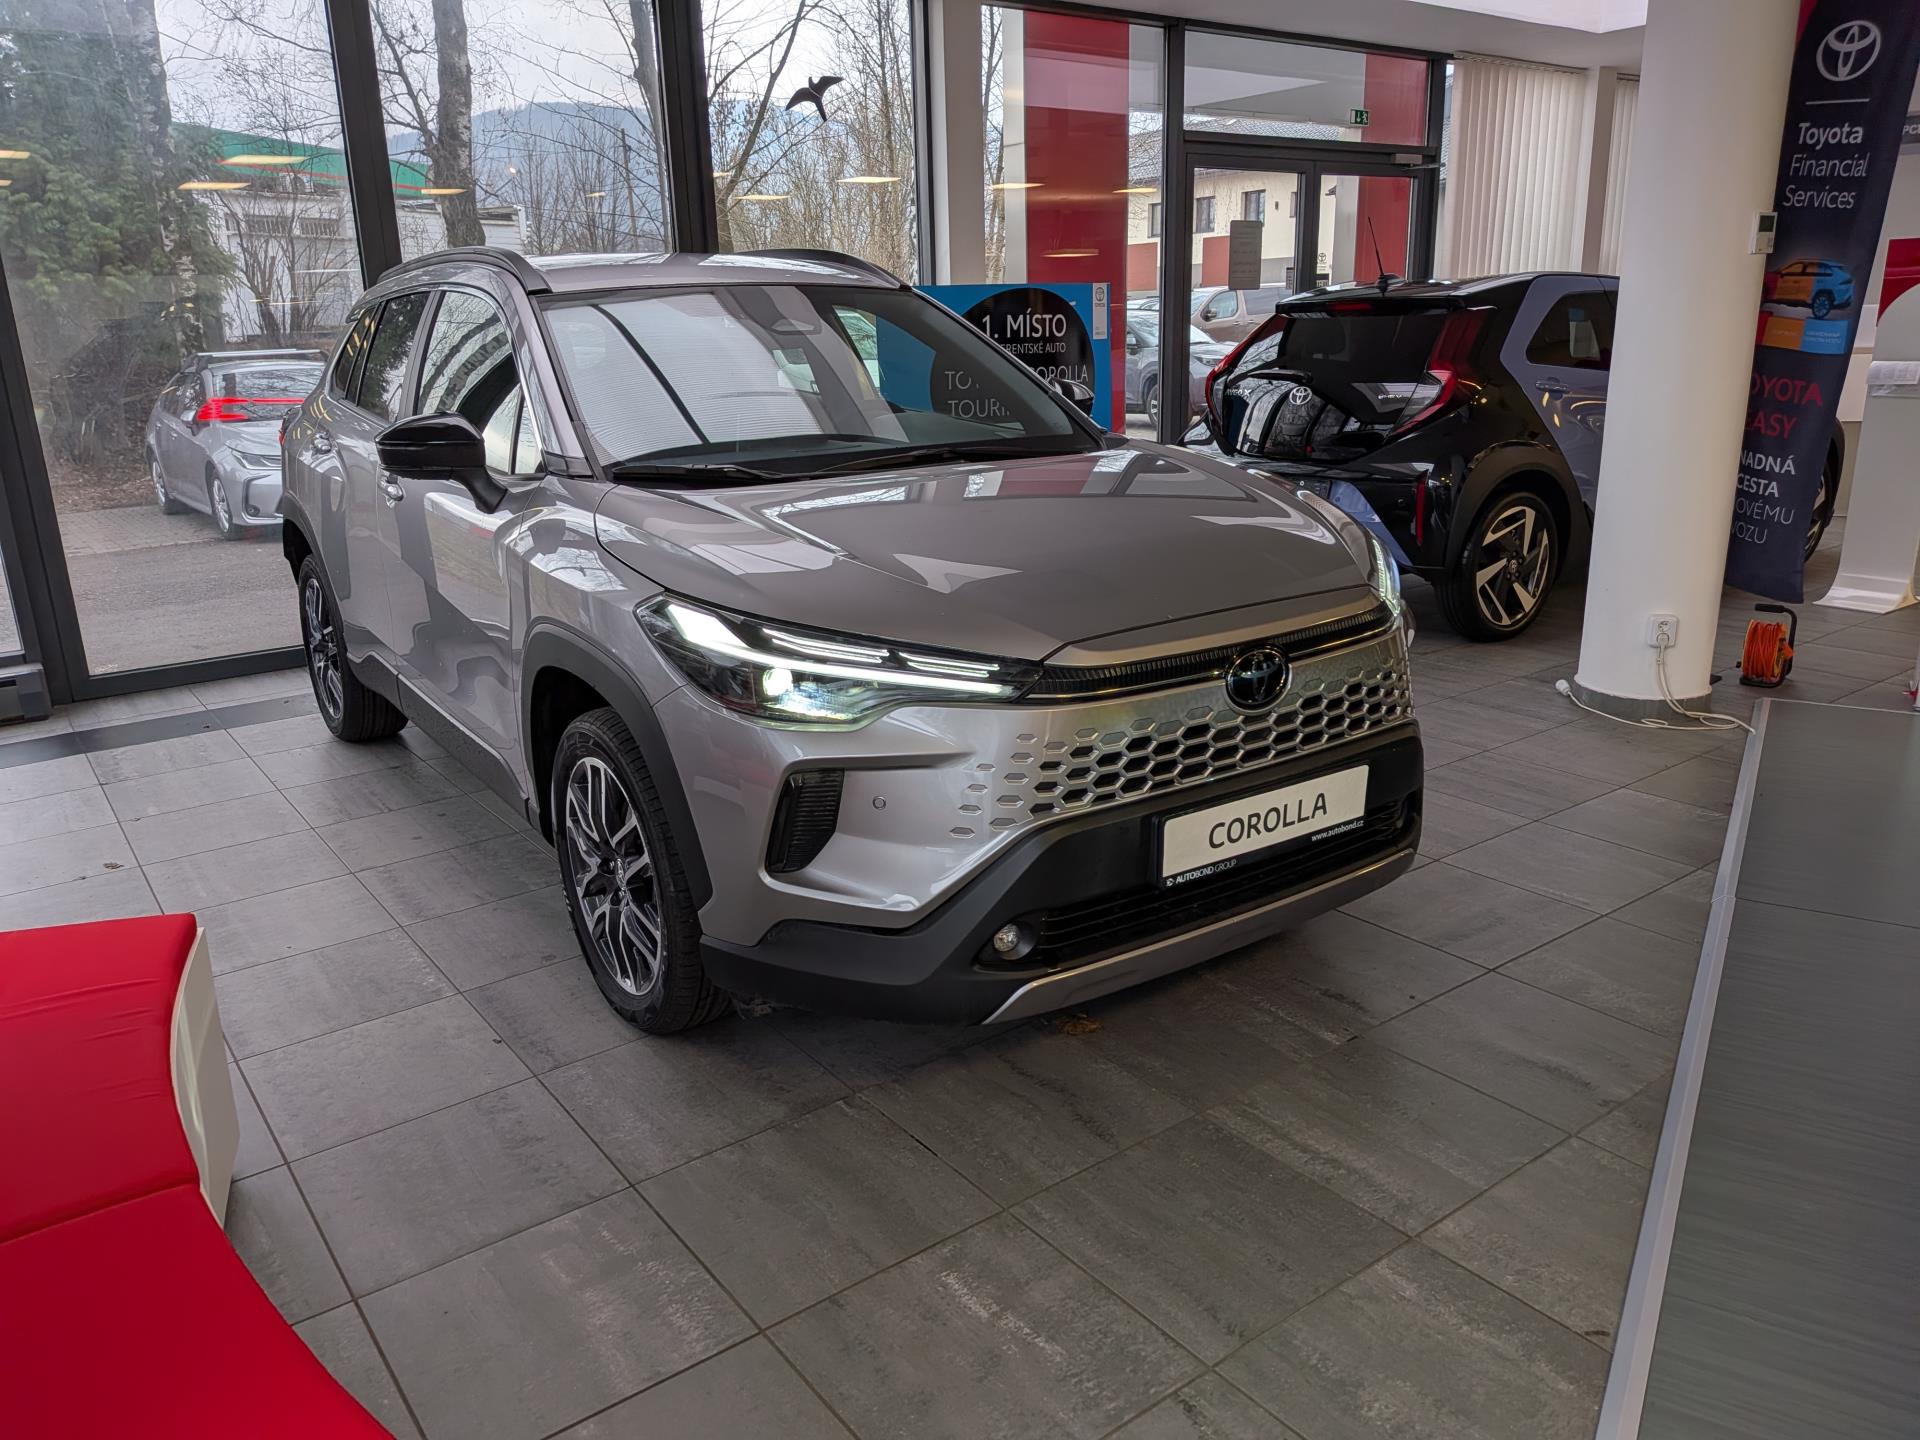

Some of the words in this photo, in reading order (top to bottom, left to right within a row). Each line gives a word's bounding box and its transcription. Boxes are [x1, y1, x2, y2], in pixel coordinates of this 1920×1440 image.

[1798, 121, 1864, 150] Toyota
[1789, 152, 1870, 177] Financial
[1782, 184, 1856, 209] Services
[982, 314, 999, 339] 1.
[1006, 307, 1067, 338] MÍSTO
[1045, 342, 1067, 353] AUTO
[1030, 364, 1089, 382] OROLLA
[1750, 410, 1797, 439] ASY
[1737, 472, 1779, 498] CESTA
[1208, 792, 1328, 849] COROLLA
[1311, 820, 1364, 842] www.autobond.cz
[1175, 865, 1214, 884] AUTOBOND
[1214, 859, 1237, 872] GROUP
